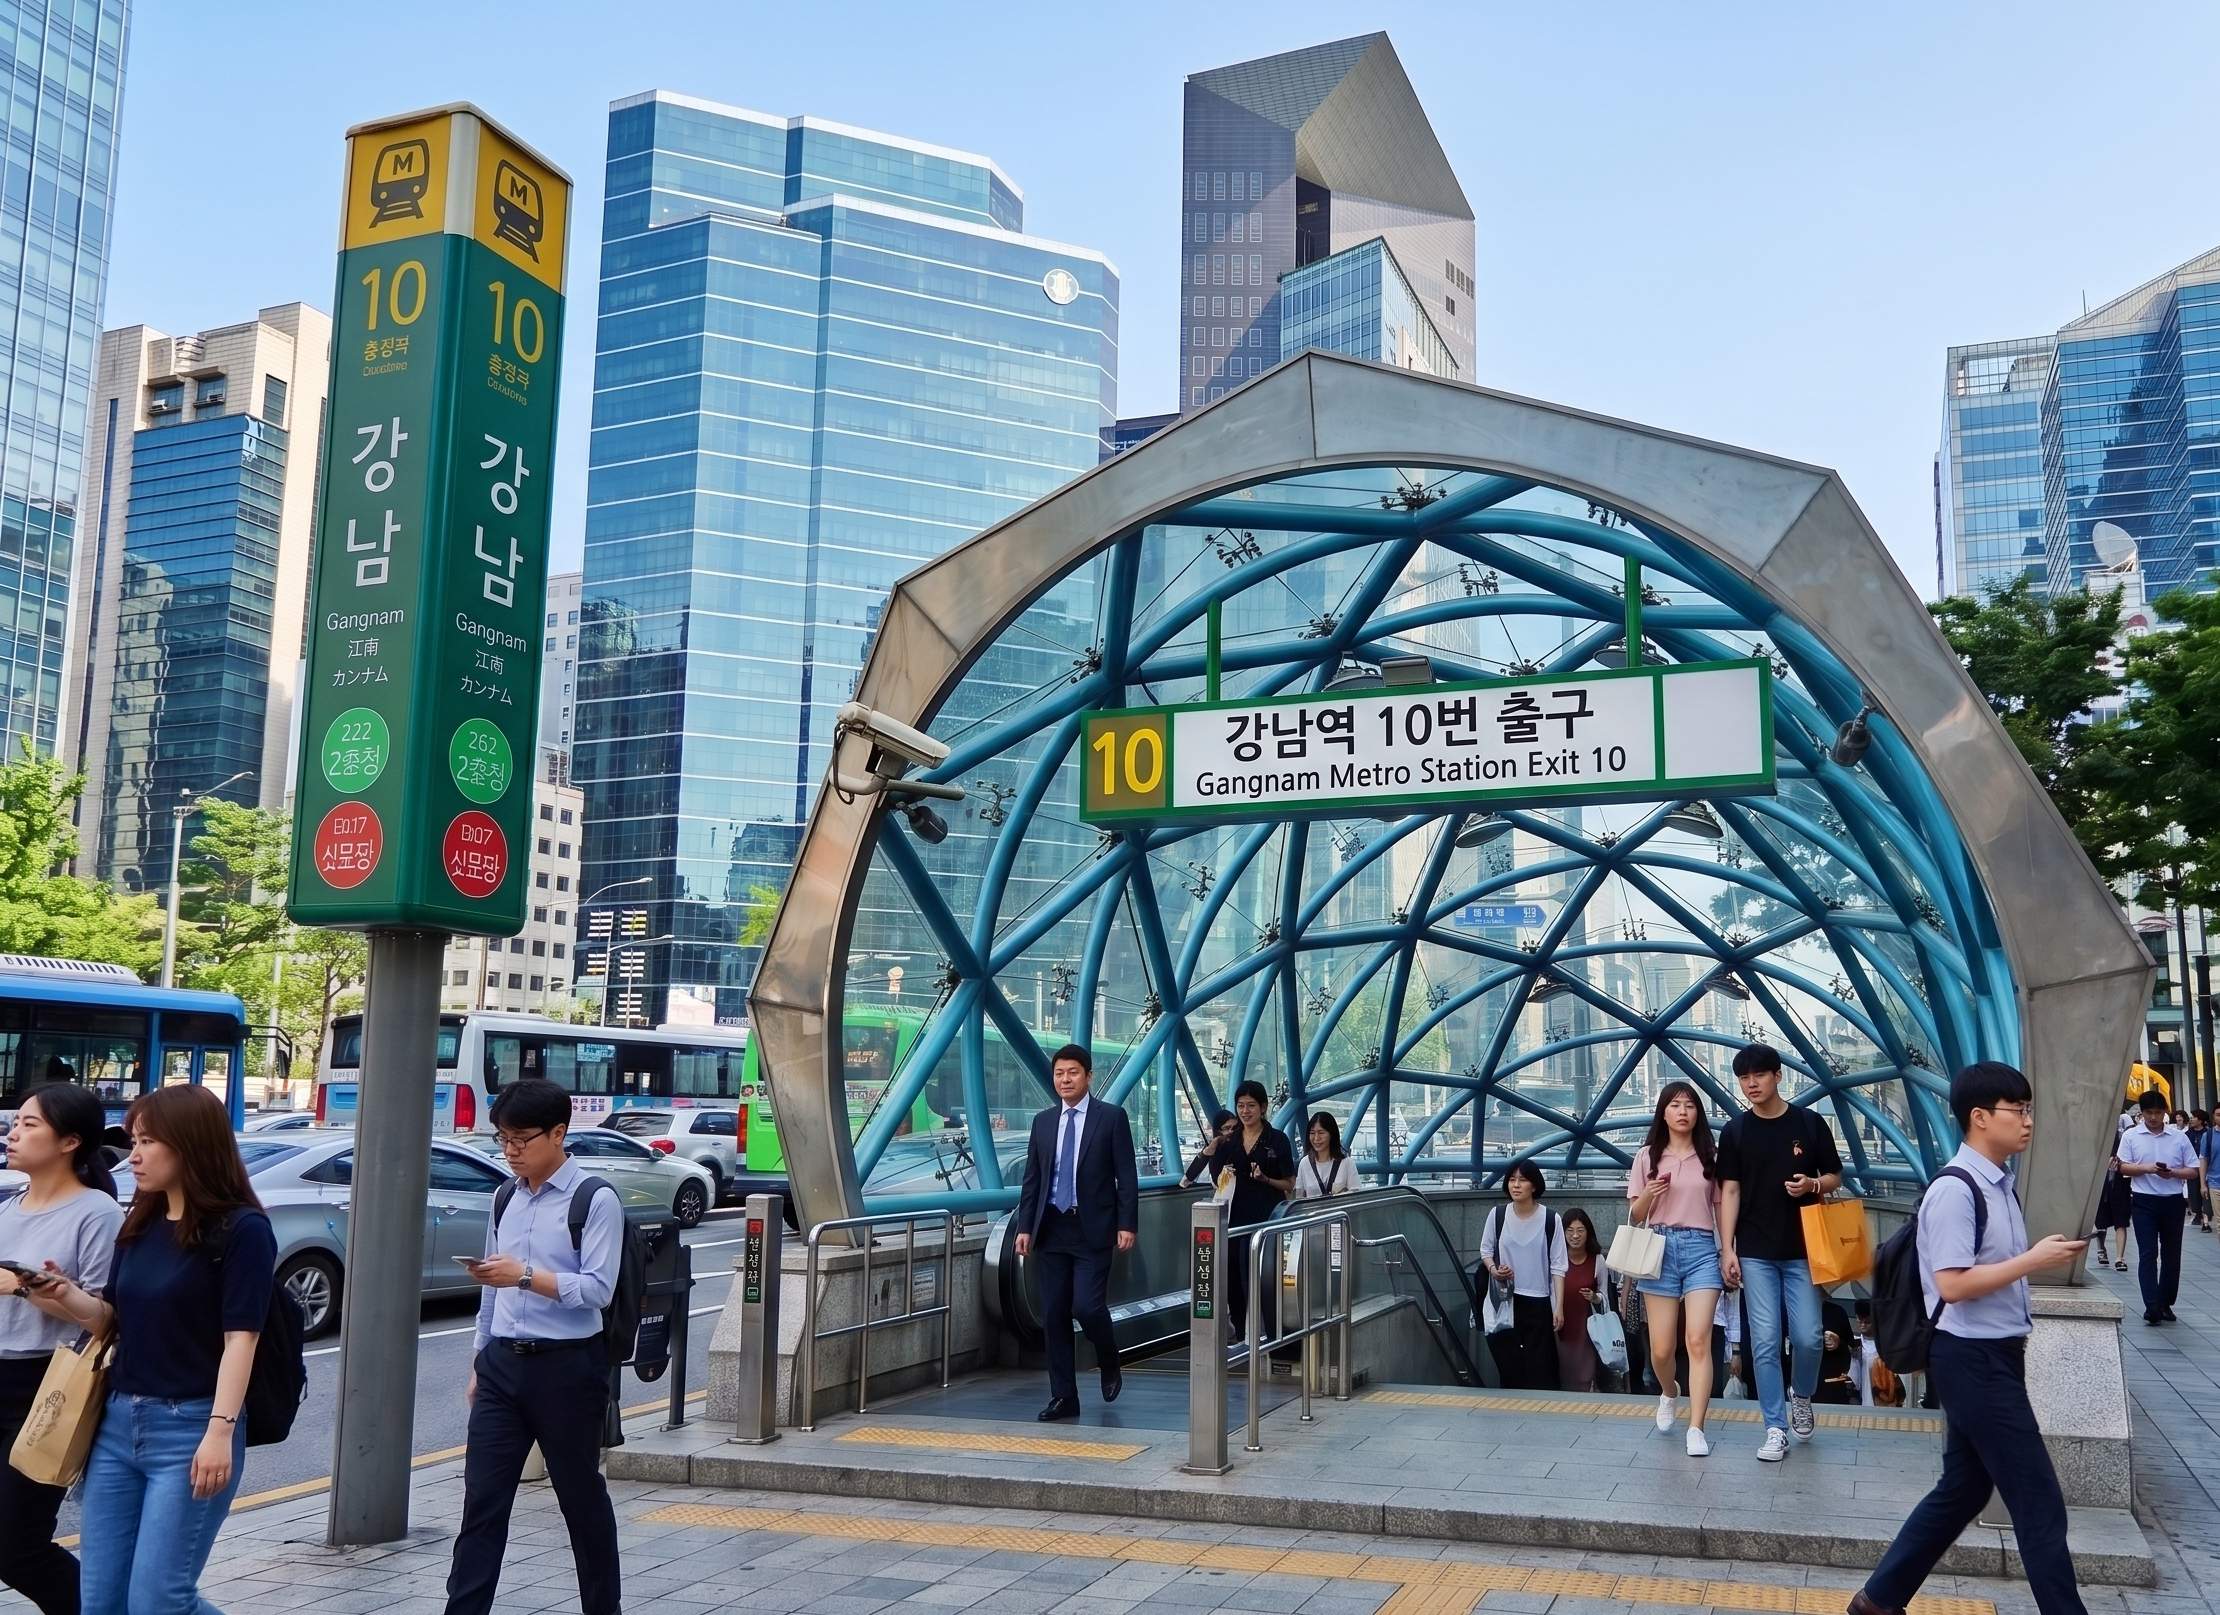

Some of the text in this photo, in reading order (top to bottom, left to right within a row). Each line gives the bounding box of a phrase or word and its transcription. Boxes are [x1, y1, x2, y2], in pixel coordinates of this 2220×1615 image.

[361, 260, 427, 331] 10
[488, 281, 544, 364] 10
[347, 416, 409, 587] 강남
[475, 433, 530, 608] 강남
[327, 608, 404, 632] Gangnam
[456, 612, 527, 652] Gangnam
[332, 665, 388, 687] カンナム
[460, 675, 512, 705] カンナム
[341, 722, 372, 742] 222
[468, 731, 497, 755] 262
[1225, 689, 1594, 762] 강남역 10번 출구
[1092, 728, 1164, 795] 10
[1195, 745, 1627, 799] Gangnam Metro Station Exit 10
